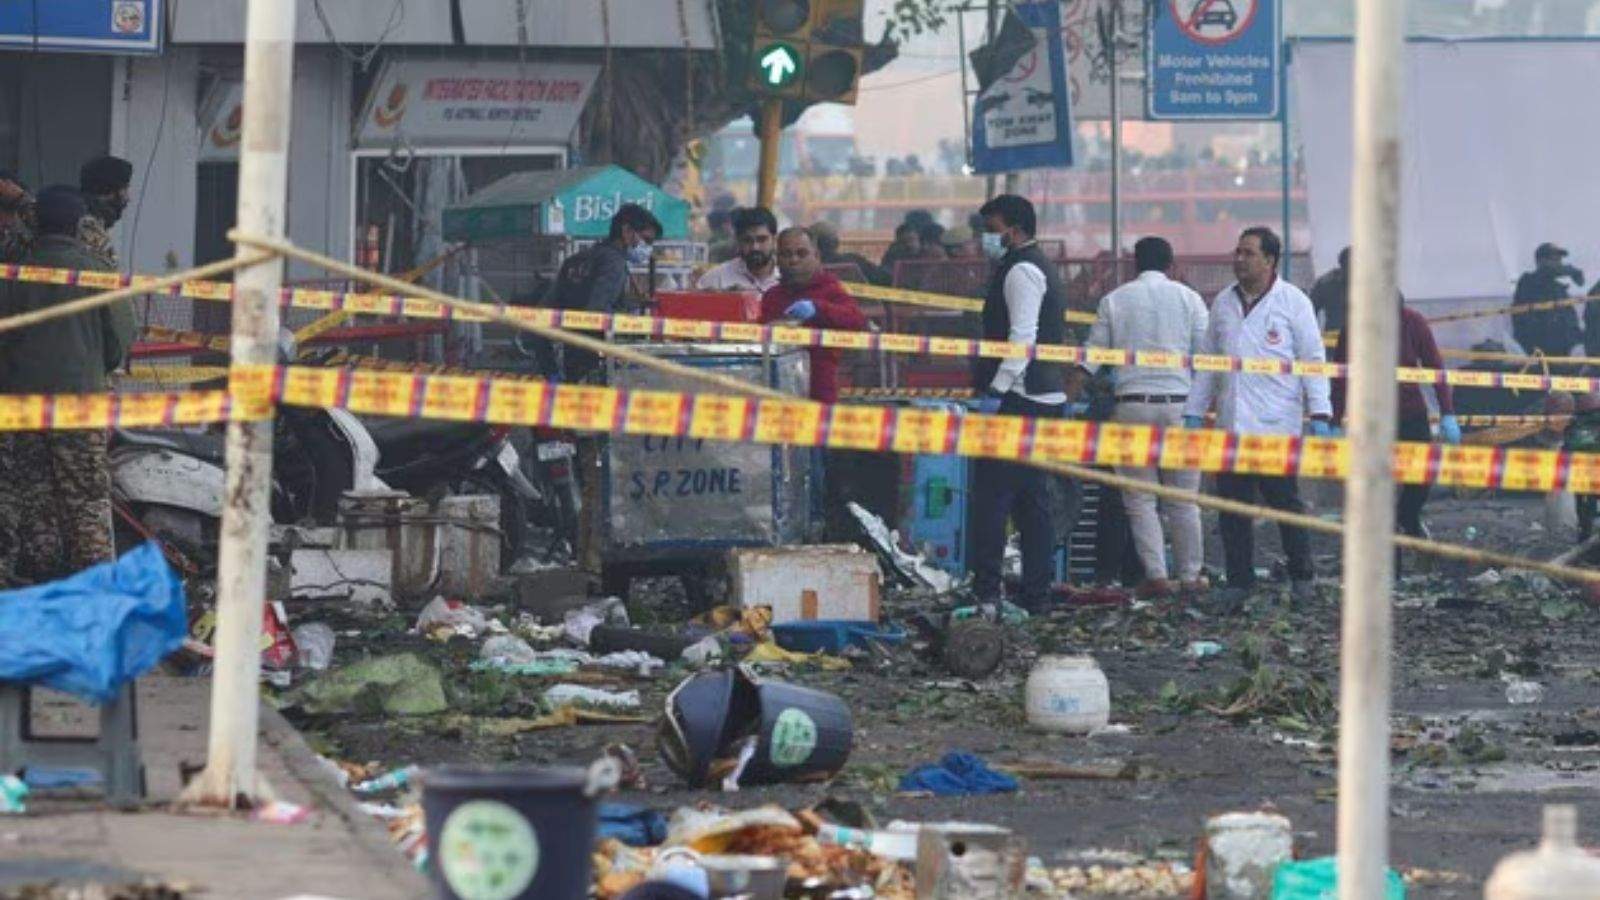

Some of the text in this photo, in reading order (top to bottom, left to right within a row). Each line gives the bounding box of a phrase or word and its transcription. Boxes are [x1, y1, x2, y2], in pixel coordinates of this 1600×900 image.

[1158, 54, 1270, 69] Motor Vehicles
[1174, 71, 1254, 86] Prohibited
[1206, 90, 1222, 104] to
[1018, 113, 1052, 124] AWAY
[1004, 126, 1038, 138] ZONE
[574, 191, 654, 222] Bislri
